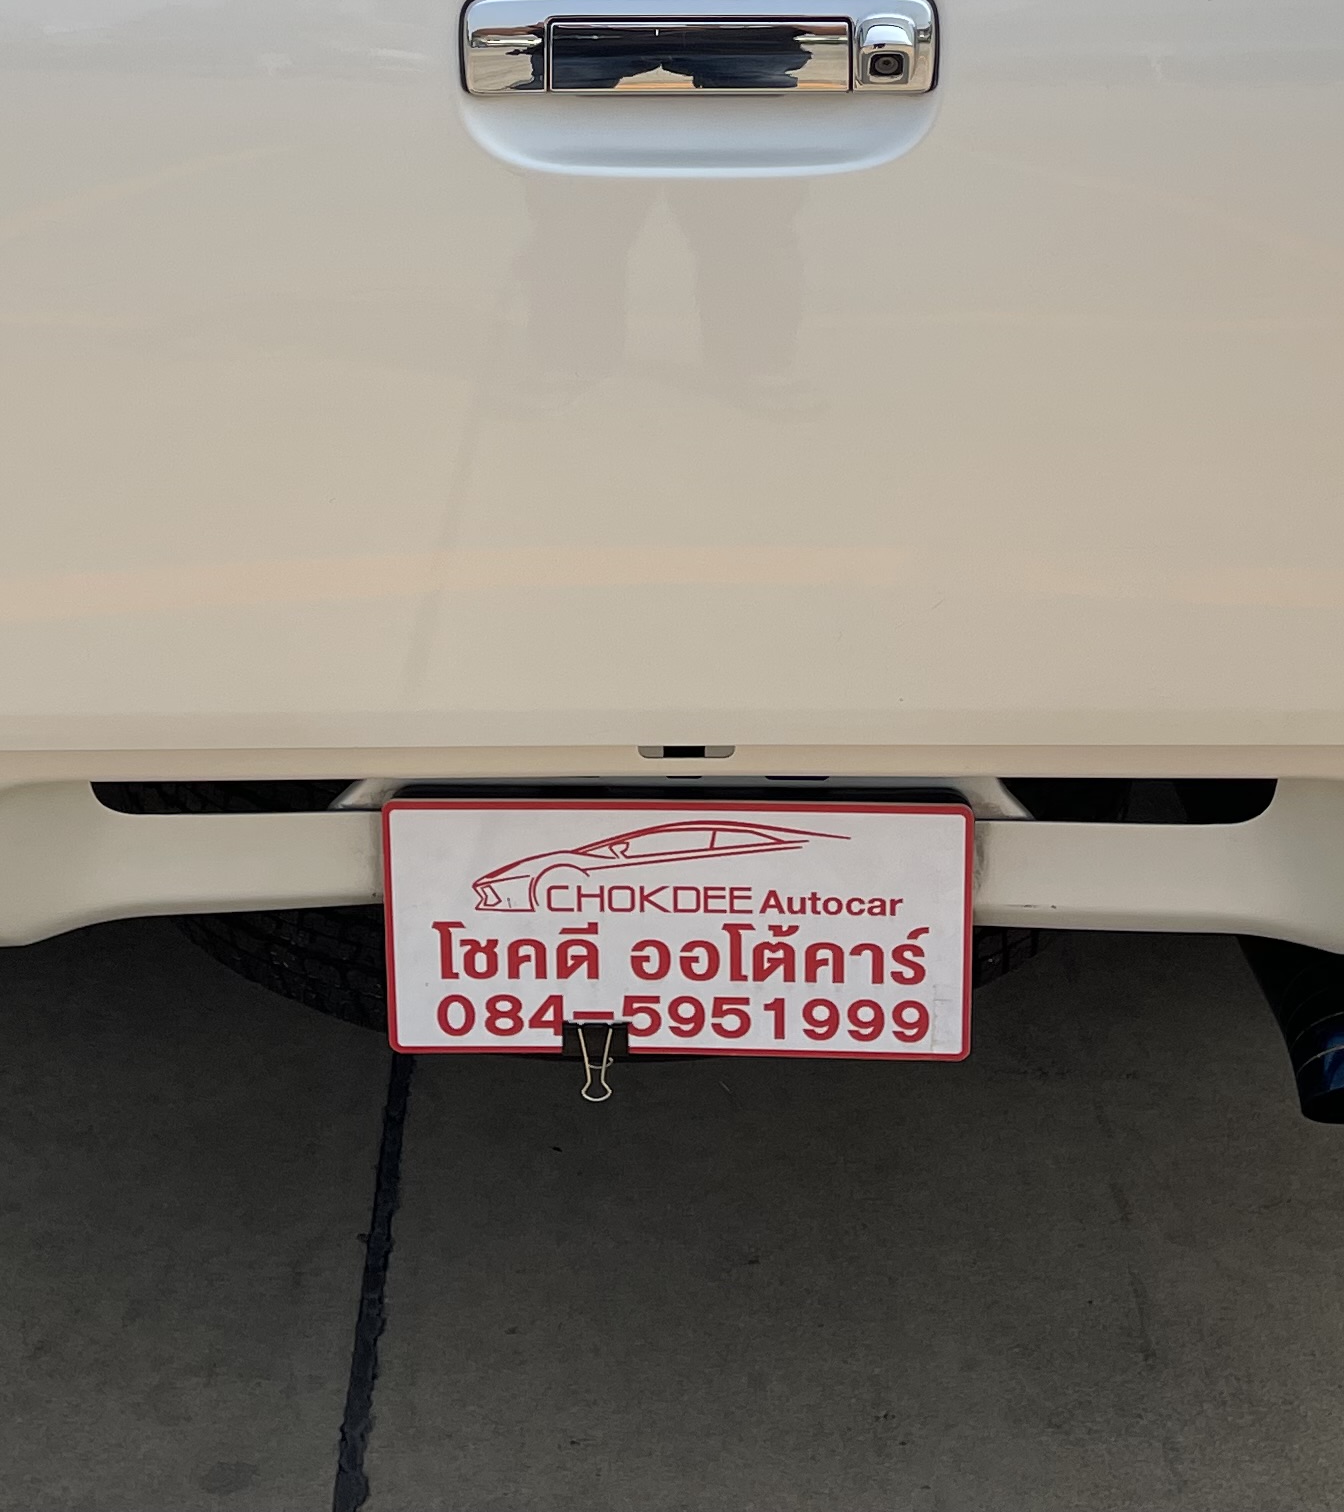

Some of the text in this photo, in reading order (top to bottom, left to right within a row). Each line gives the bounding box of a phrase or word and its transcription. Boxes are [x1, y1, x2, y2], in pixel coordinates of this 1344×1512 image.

[545, 885, 904, 917] CHOKDEE Autocar
[432, 921, 930, 986] โชคดี ออโต้คาร์
[437, 994, 930, 1043] 084-5951999
